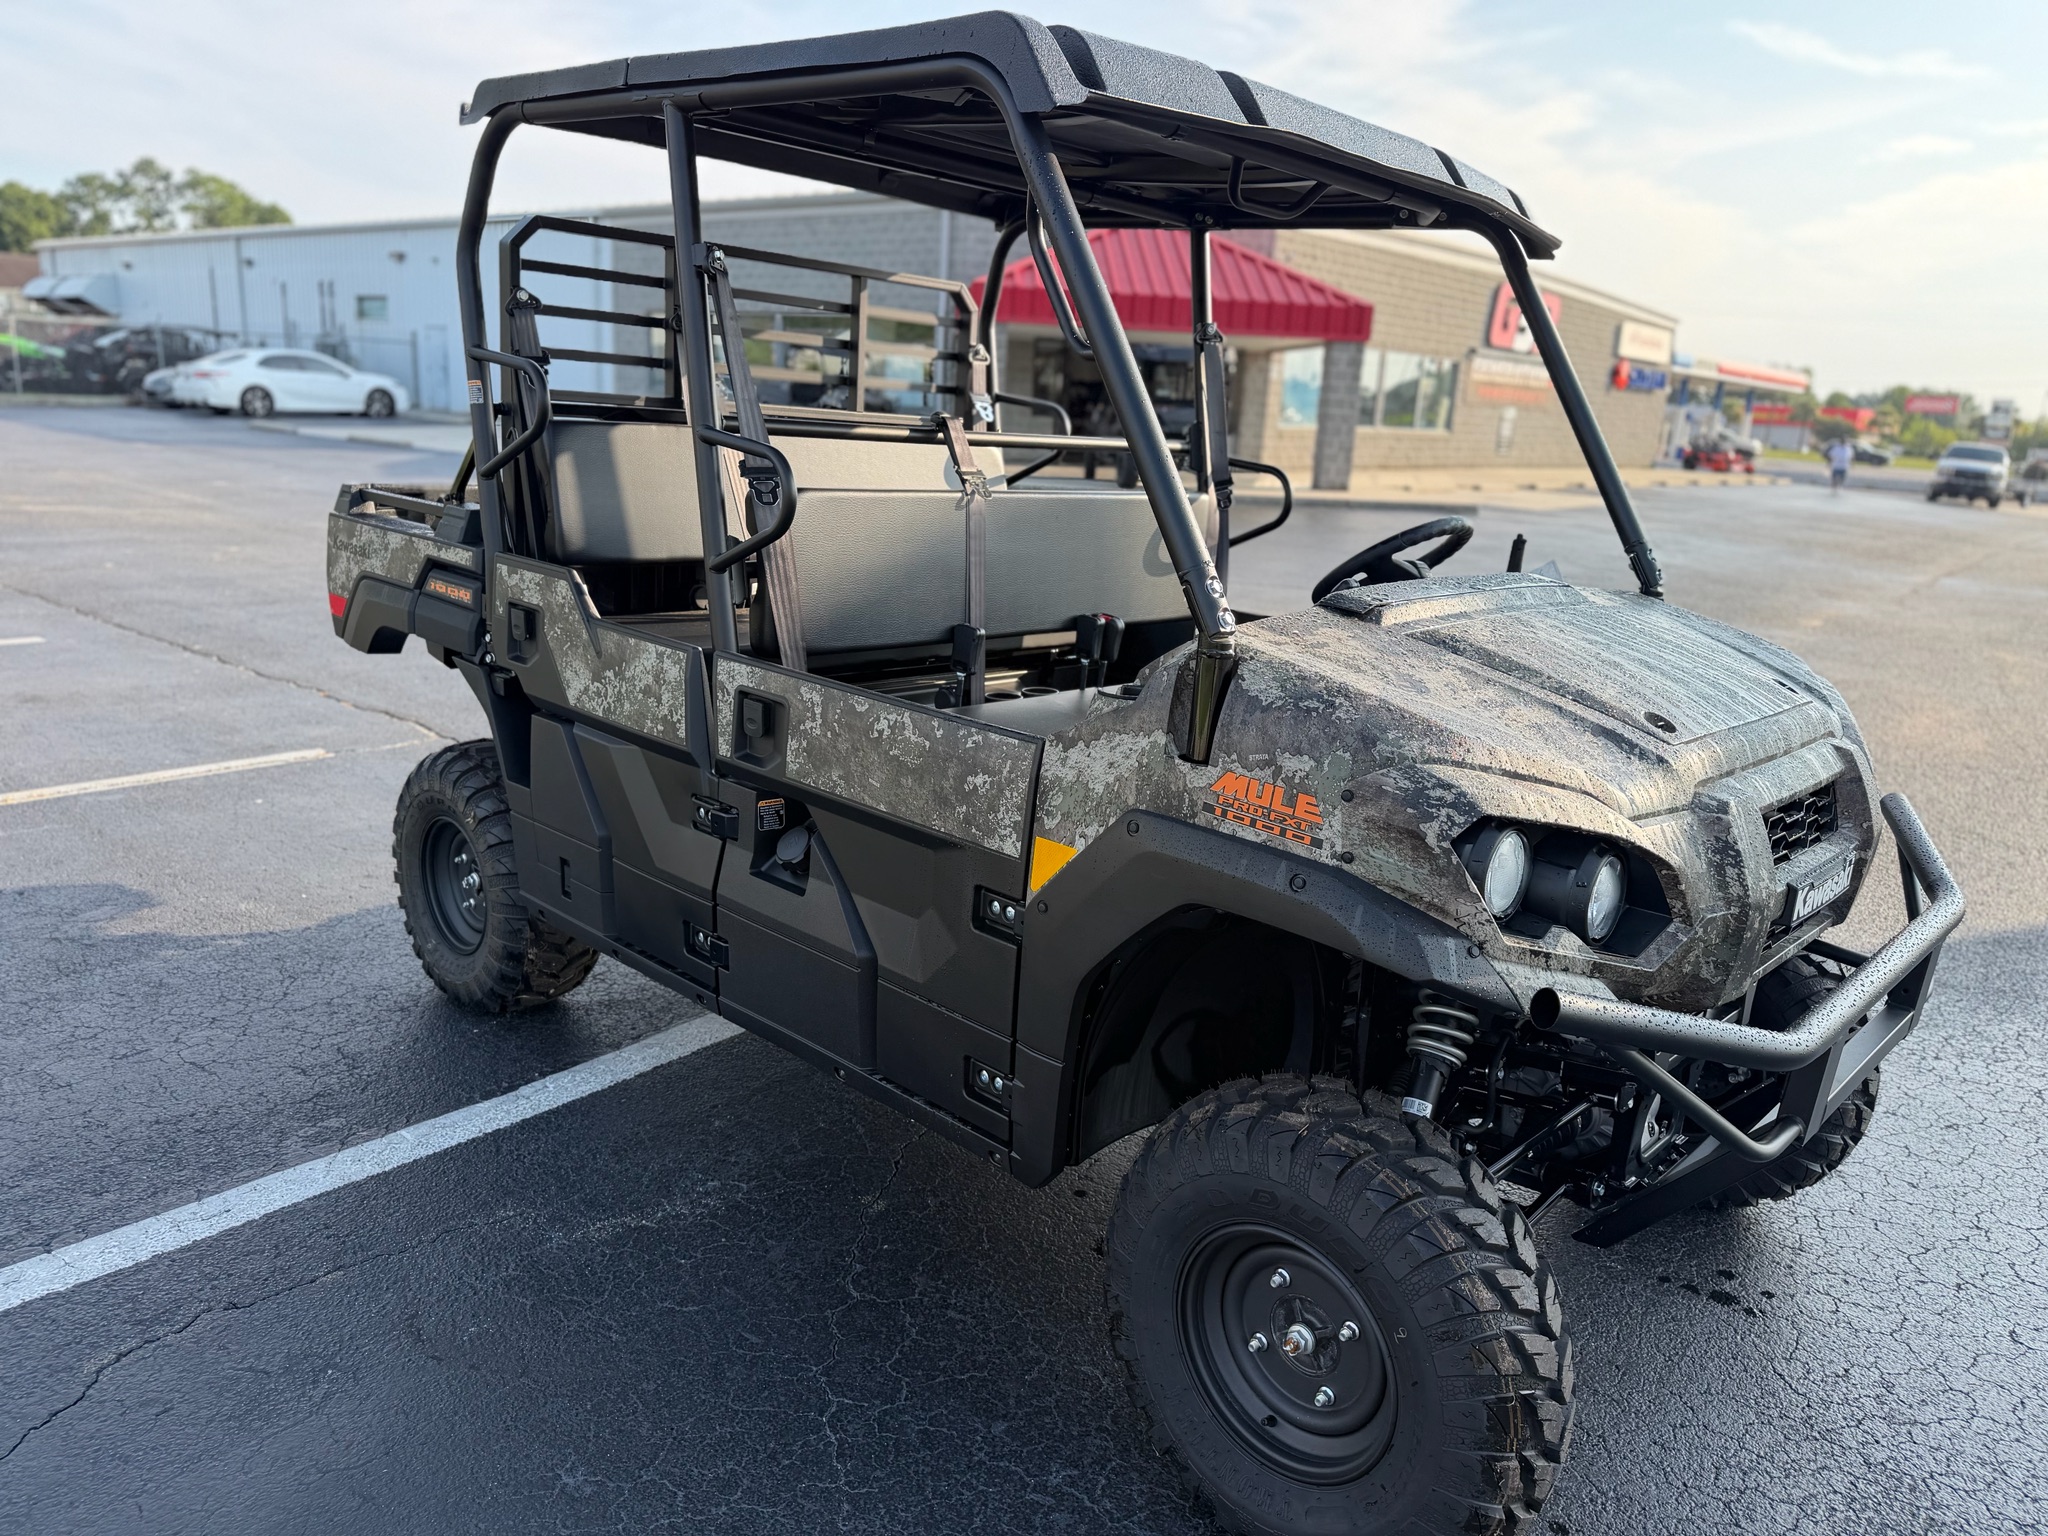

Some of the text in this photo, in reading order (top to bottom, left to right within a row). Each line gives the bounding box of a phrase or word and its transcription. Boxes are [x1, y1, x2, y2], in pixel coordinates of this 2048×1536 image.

[1248, 753, 1269, 762] STRATA
[1210, 771, 1323, 824] MULE
[1214, 805, 1312, 845] 1000
[1793, 854, 1855, 921] Kawasaki
